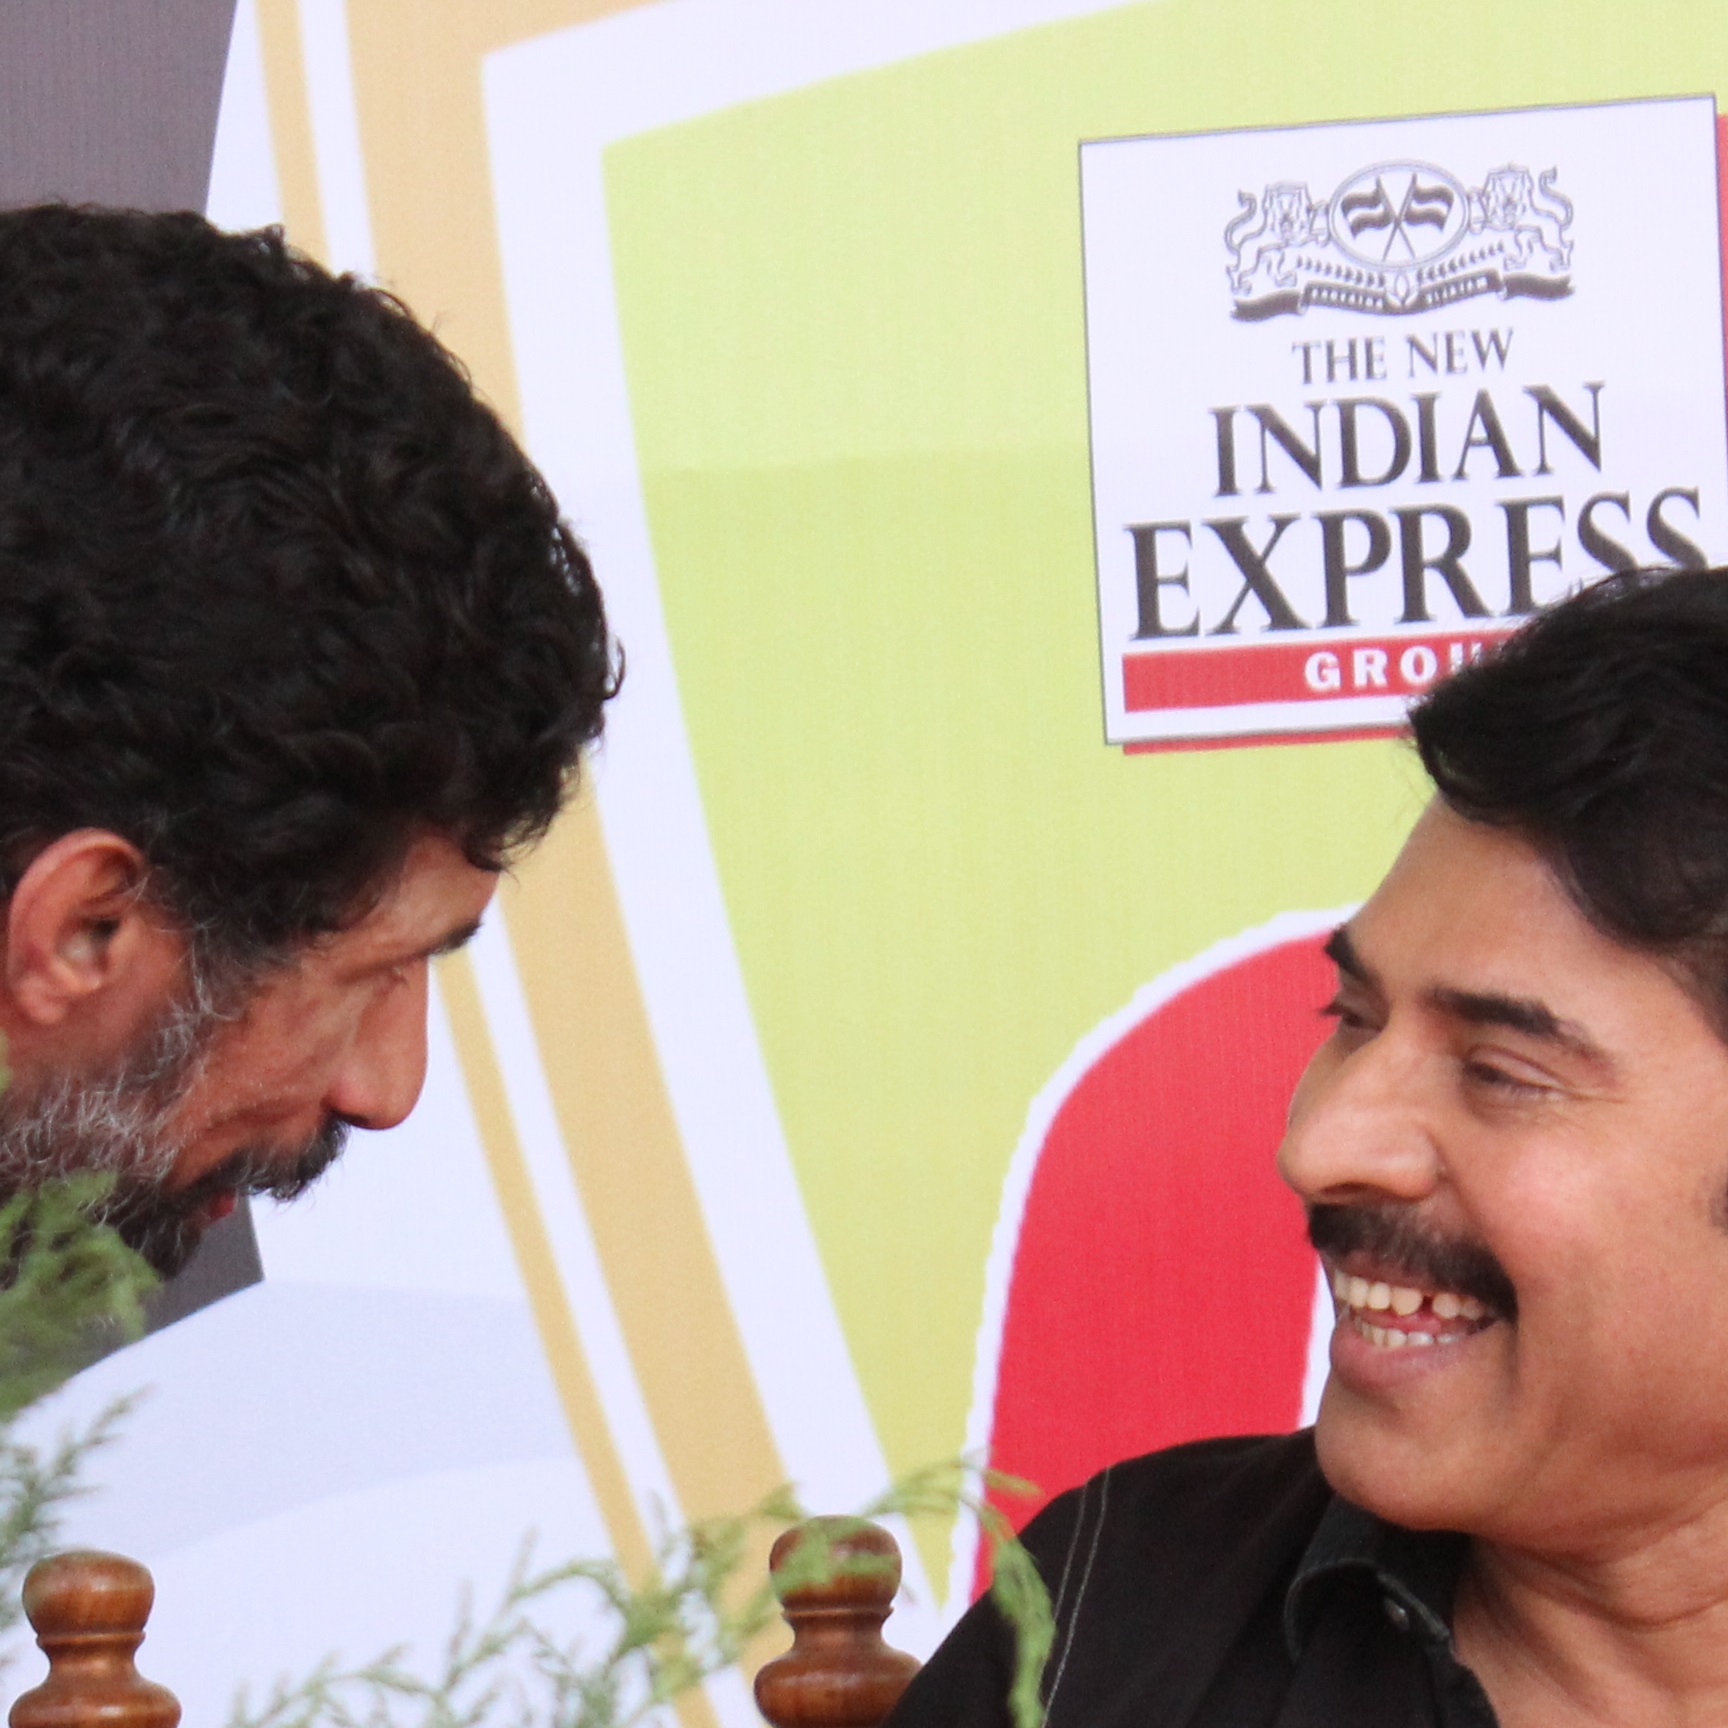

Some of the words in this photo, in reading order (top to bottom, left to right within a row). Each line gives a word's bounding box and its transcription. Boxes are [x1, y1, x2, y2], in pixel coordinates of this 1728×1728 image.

[1292, 337, 1388, 385] THE
[1405, 326, 1515, 378] NEW
[1209, 380, 1606, 498] INDIAN
[1122, 485, 1708, 643] EXPRESS
[1304, 641, 1488, 692] GROU
